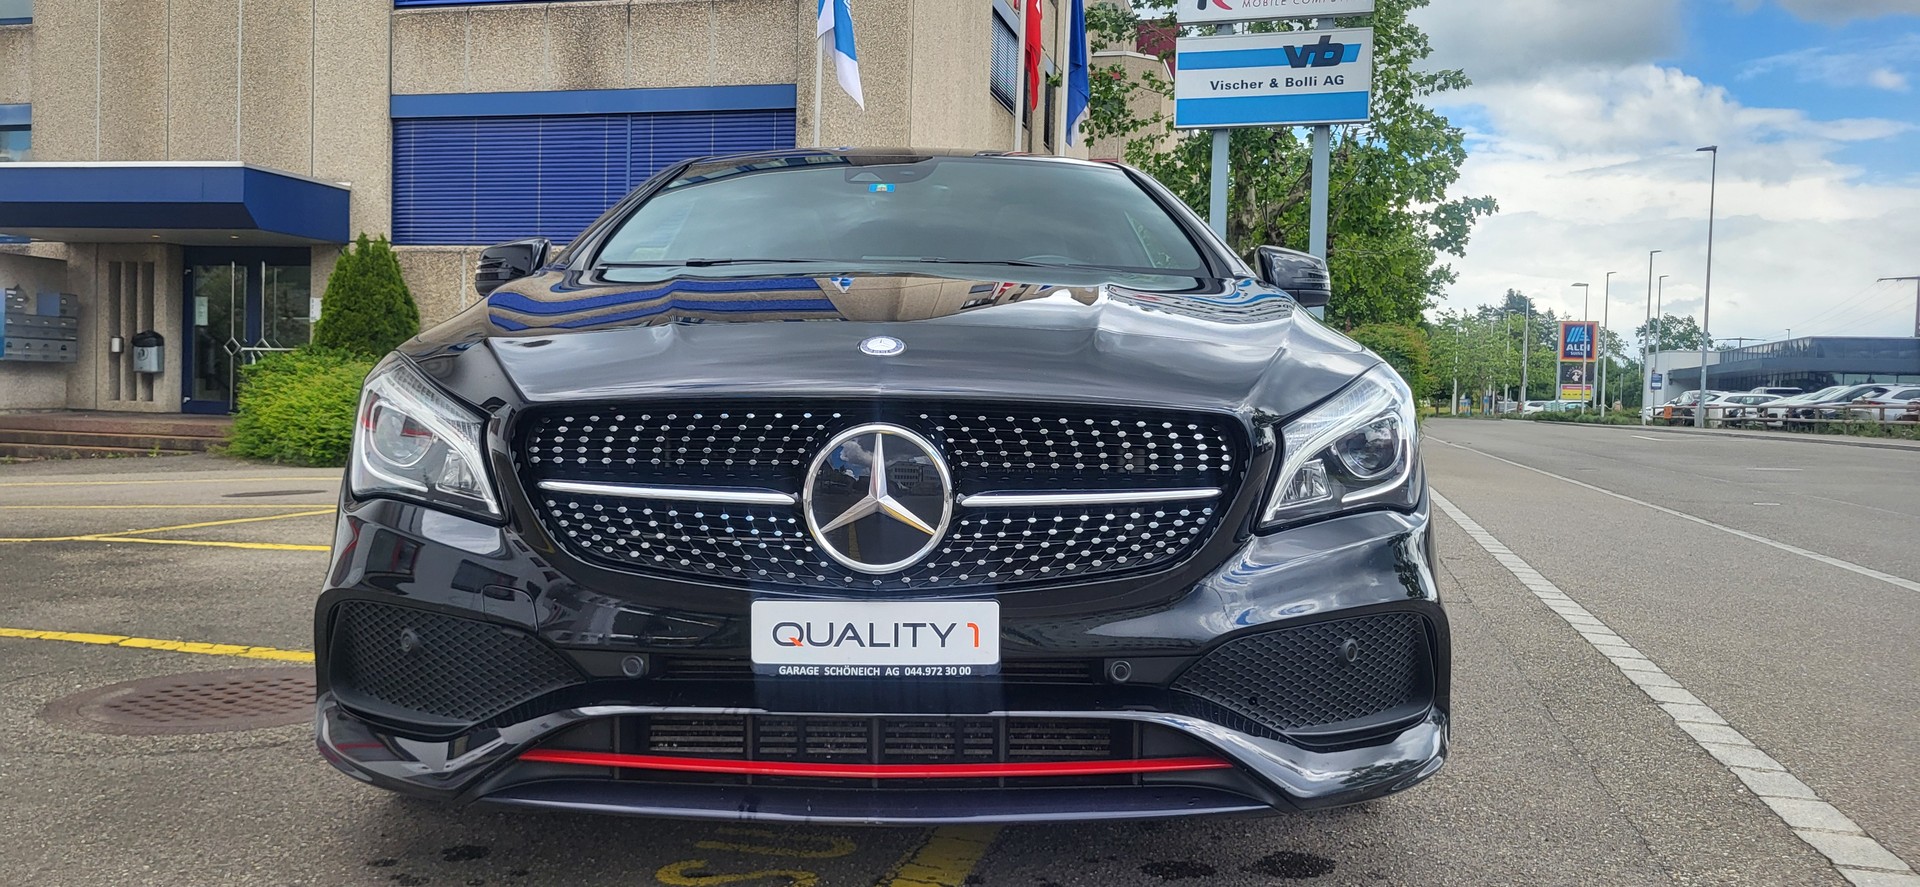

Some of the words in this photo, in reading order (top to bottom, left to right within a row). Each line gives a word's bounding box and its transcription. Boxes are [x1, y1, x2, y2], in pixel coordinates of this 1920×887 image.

[1210, 80, 1263, 91] Vischer
[1269, 78, 1279, 88] &
[1285, 76, 1317, 88] Bolli
[1323, 74, 1344, 86] AG
[1566, 343, 1591, 351] ALDI
[772, 622, 957, 648] QUALITY
[967, 622, 979, 648] 1
[779, 666, 820, 676] GARAGE
[824, 665, 880, 676] SCHÖNEICH
[885, 667, 900, 676] AG
[904, 667, 943, 676] 044.972
[945, 667, 957, 676] 30
[959, 667, 971, 676] 00
